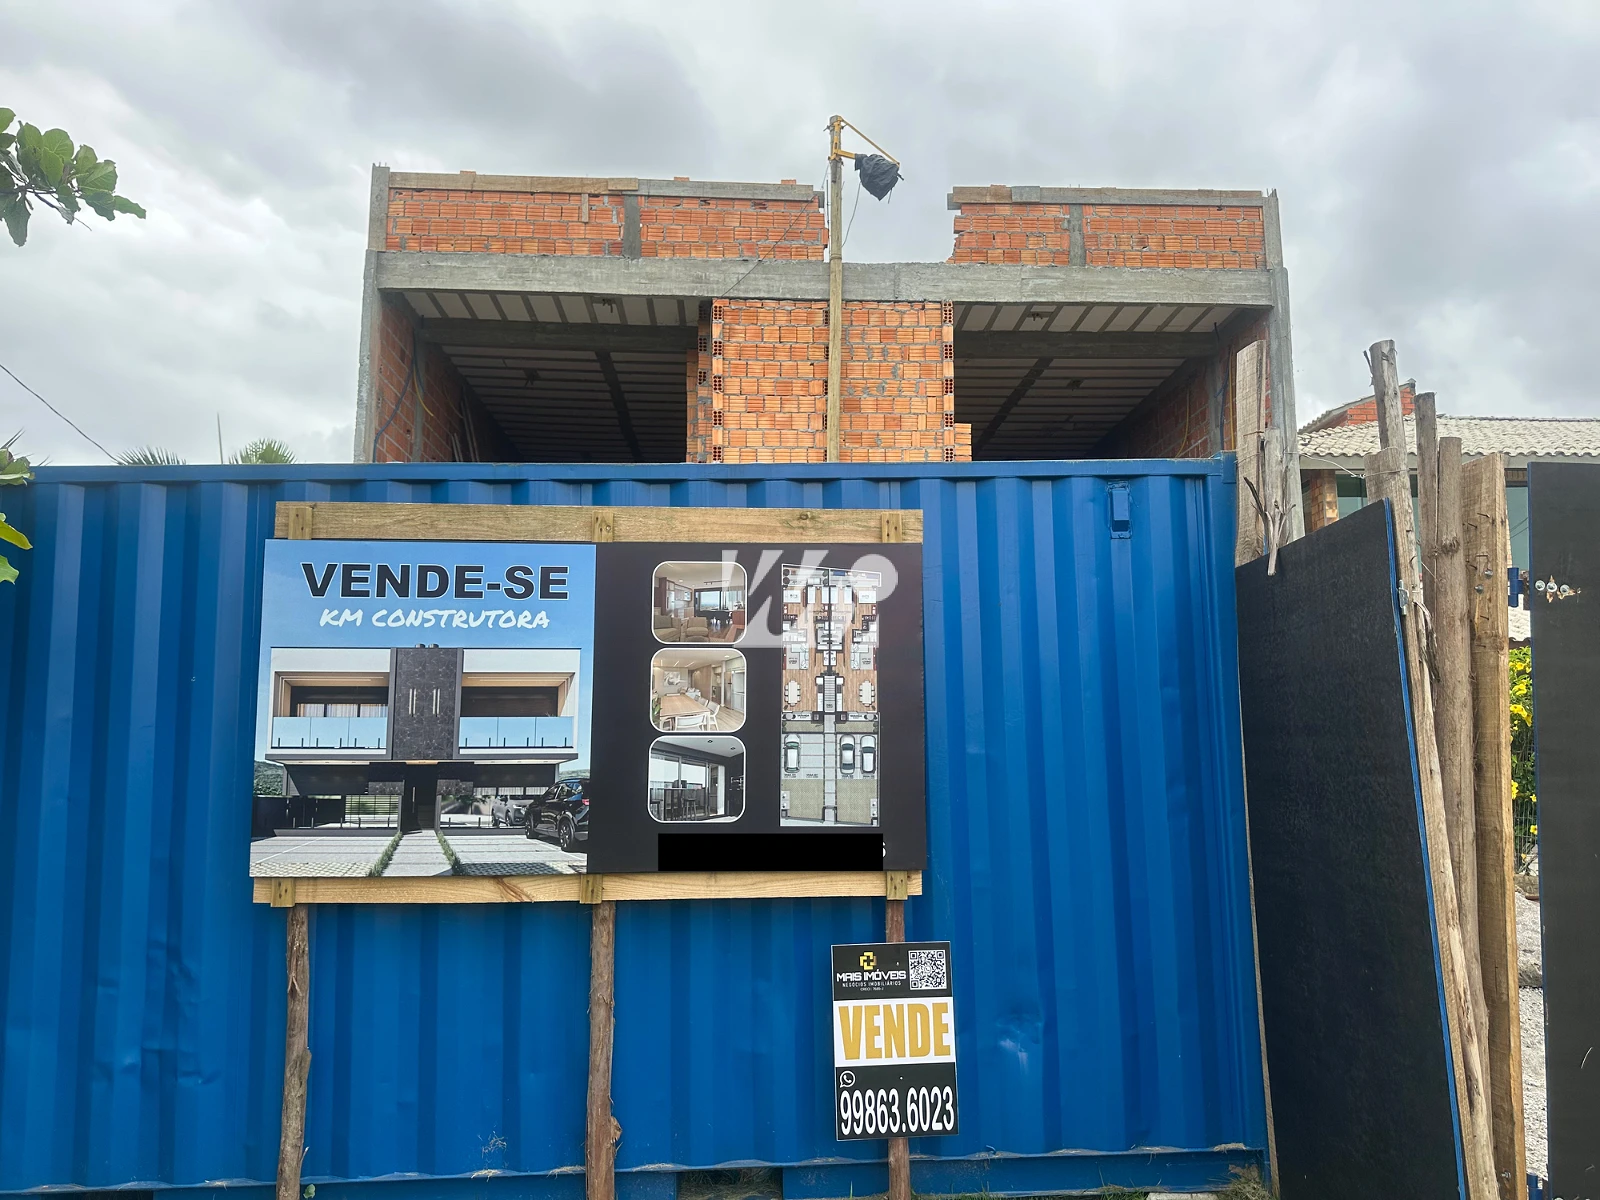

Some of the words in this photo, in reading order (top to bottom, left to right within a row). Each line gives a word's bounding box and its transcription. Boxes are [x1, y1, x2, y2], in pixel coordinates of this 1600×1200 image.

[301, 562, 570, 600] VENDE-SE
[319, 608, 363, 627] KM
[371, 608, 550, 629] CONSTRUTORA
[836, 973, 862, 982] MAIS
[864, 969, 907, 981] IMÓVEIS
[838, 1002, 951, 1060] VENDE
[840, 1086, 954, 1135] 99863.6023
